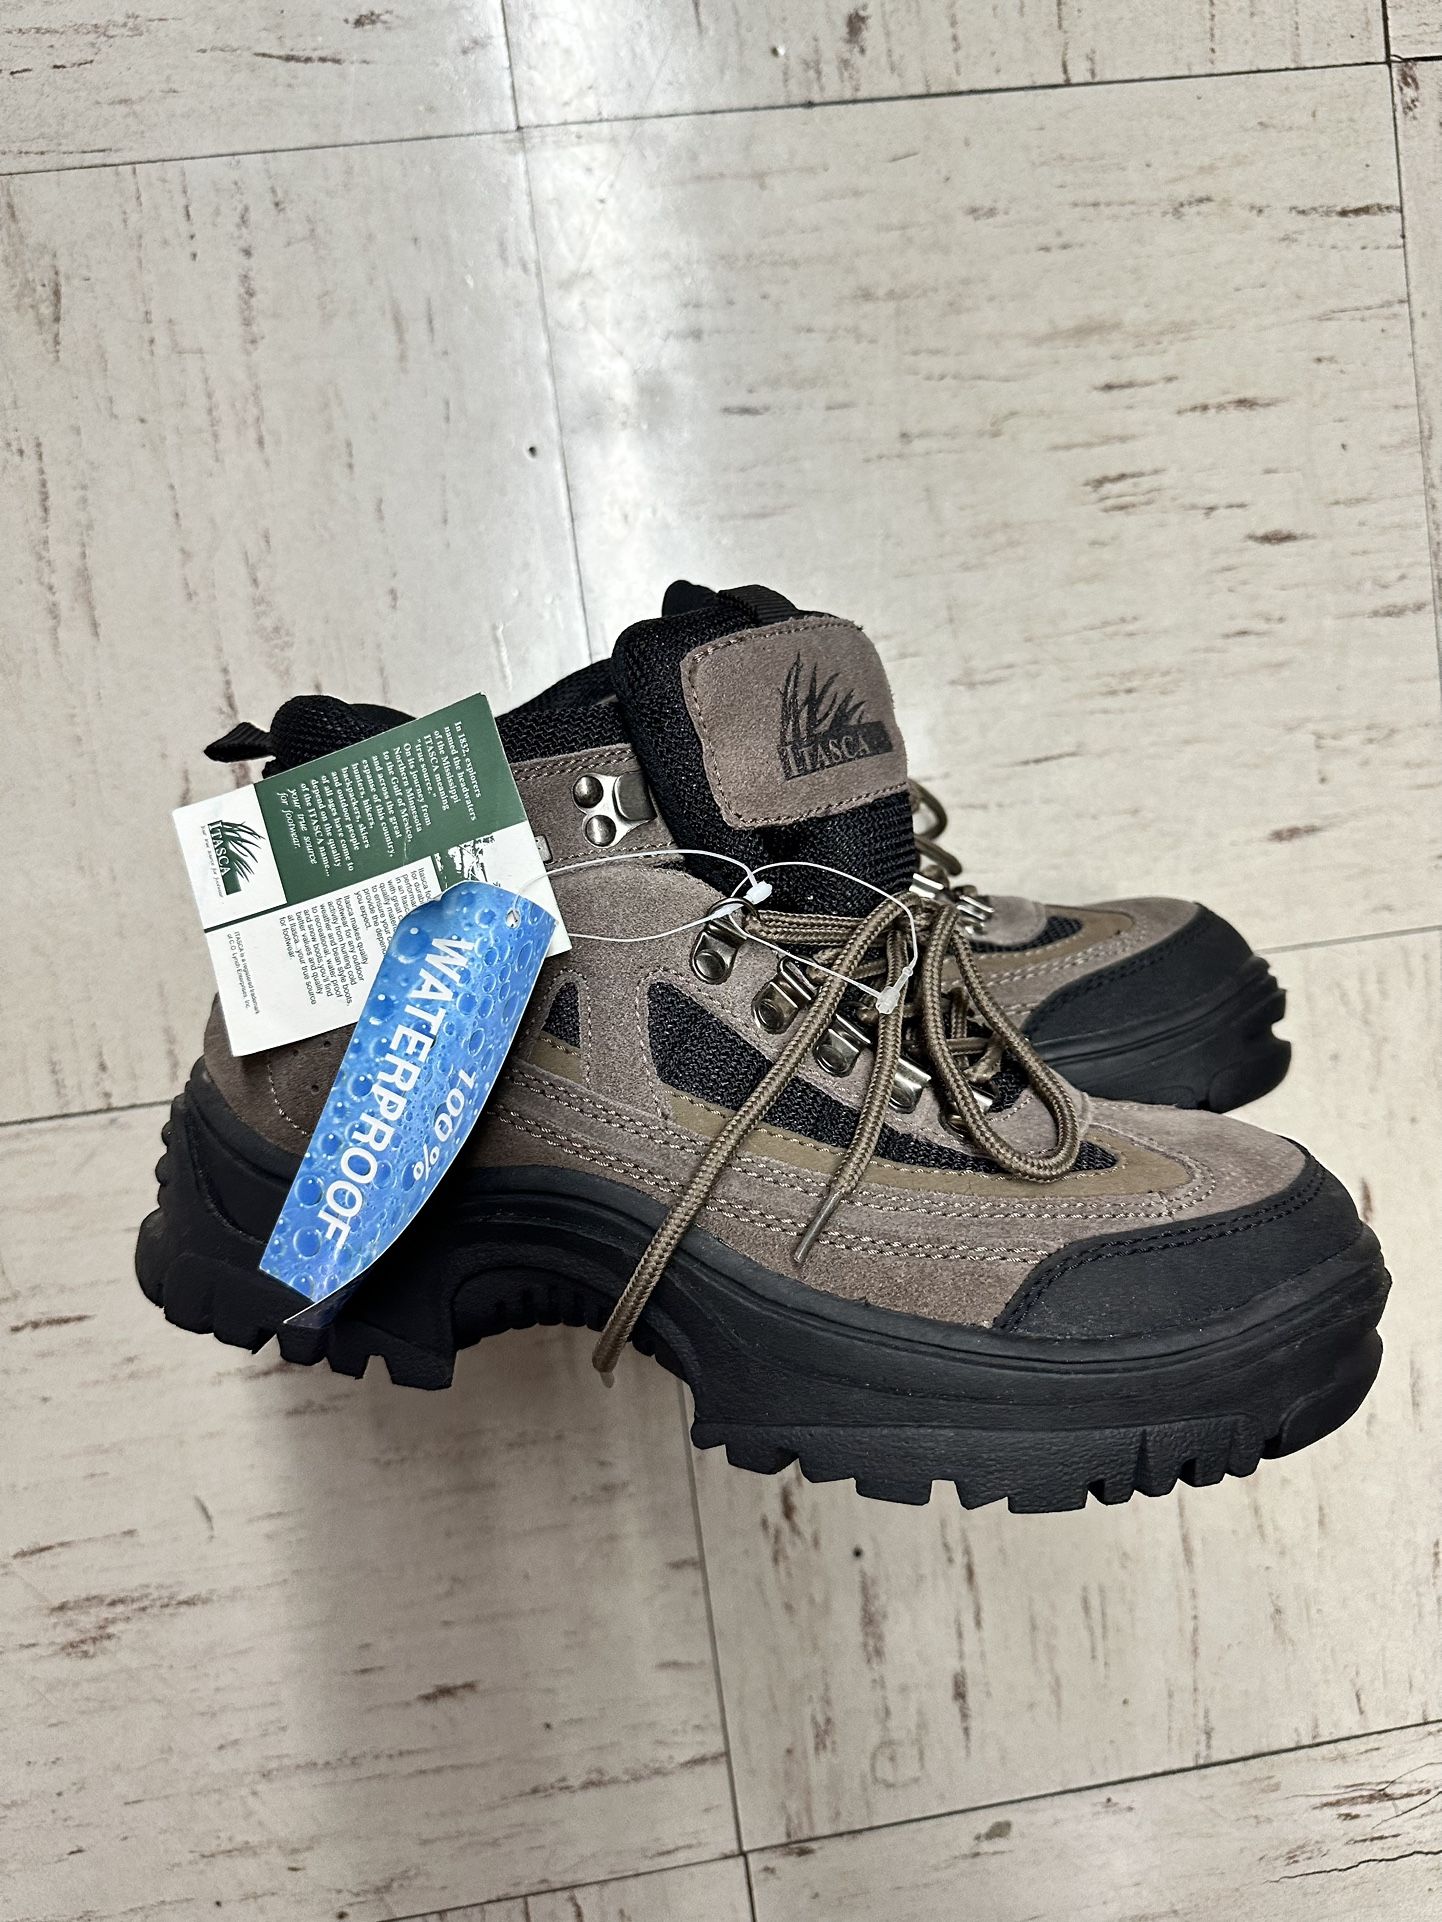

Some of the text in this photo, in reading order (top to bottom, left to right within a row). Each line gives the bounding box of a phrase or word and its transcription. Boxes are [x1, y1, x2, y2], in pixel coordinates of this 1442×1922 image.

[393, 746, 422, 832] Northern Minnesota
[403, 742, 411, 757] On
[409, 770, 424, 802] journey
[420, 804, 431, 825] from
[414, 738, 436, 797] "true source."
[423, 734, 449, 810] ITASCA meaning
[433, 730, 461, 803] of the Mississippi
[443, 726, 476, 820] named the headwaters
[454, 721, 481, 797] In 1832, explorers
[783, 733, 873, 776] ITASCA
[276, 792, 300, 848] for footwear.
[287, 788, 317, 864] your true source
[300, 783, 330, 876] of the ITASCA name...
[310, 779, 340, 866] depend on the quality
[321, 775, 353, 871] of all ages have come to
[331, 771, 360, 850] and outdoor people
[340, 766, 370, 848] backpackers, skiers
[351, 762, 375, 828] hunters, hikers,
[361, 759, 395, 857] expanse of this country,
[371, 755, 402, 838] and across the great
[382, 750, 412, 842] to the Gulf of Mexico,
[208, 823, 232, 877] ITASCA
[387, 879, 395, 894] with
[417, 867, 428, 889] Itasca
[343, 894, 368, 964] Itasca makes quality
[362, 887, 375, 913] provide
[373, 893, 385, 918] ensure
[379, 918, 390, 934] your
[378, 882, 390, 905] quality
[390, 895, 402, 913] great
[295, 911, 305, 931] better
[301, 932, 312, 955] values
[311, 971, 323, 994] quality
[307, 923, 316, 942] snow
[324, 982, 333, 996] find
[319, 903, 331, 930] weather
[331, 946, 341, 965] bean
[337, 966, 346, 982] style
[326, 958, 336, 977] water
[327, 900, 357, 985] activity from hunting cold
[335, 897, 348, 927] footwear
[351, 954, 364, 980] outdoor
[301, 965, 309, 979] true
[305, 980, 316, 1004] source
[330, 979, 343, 997] proof
[317, 936, 474, 1251] WATERPROOF
[413, 1069, 478, 1181] 100%
